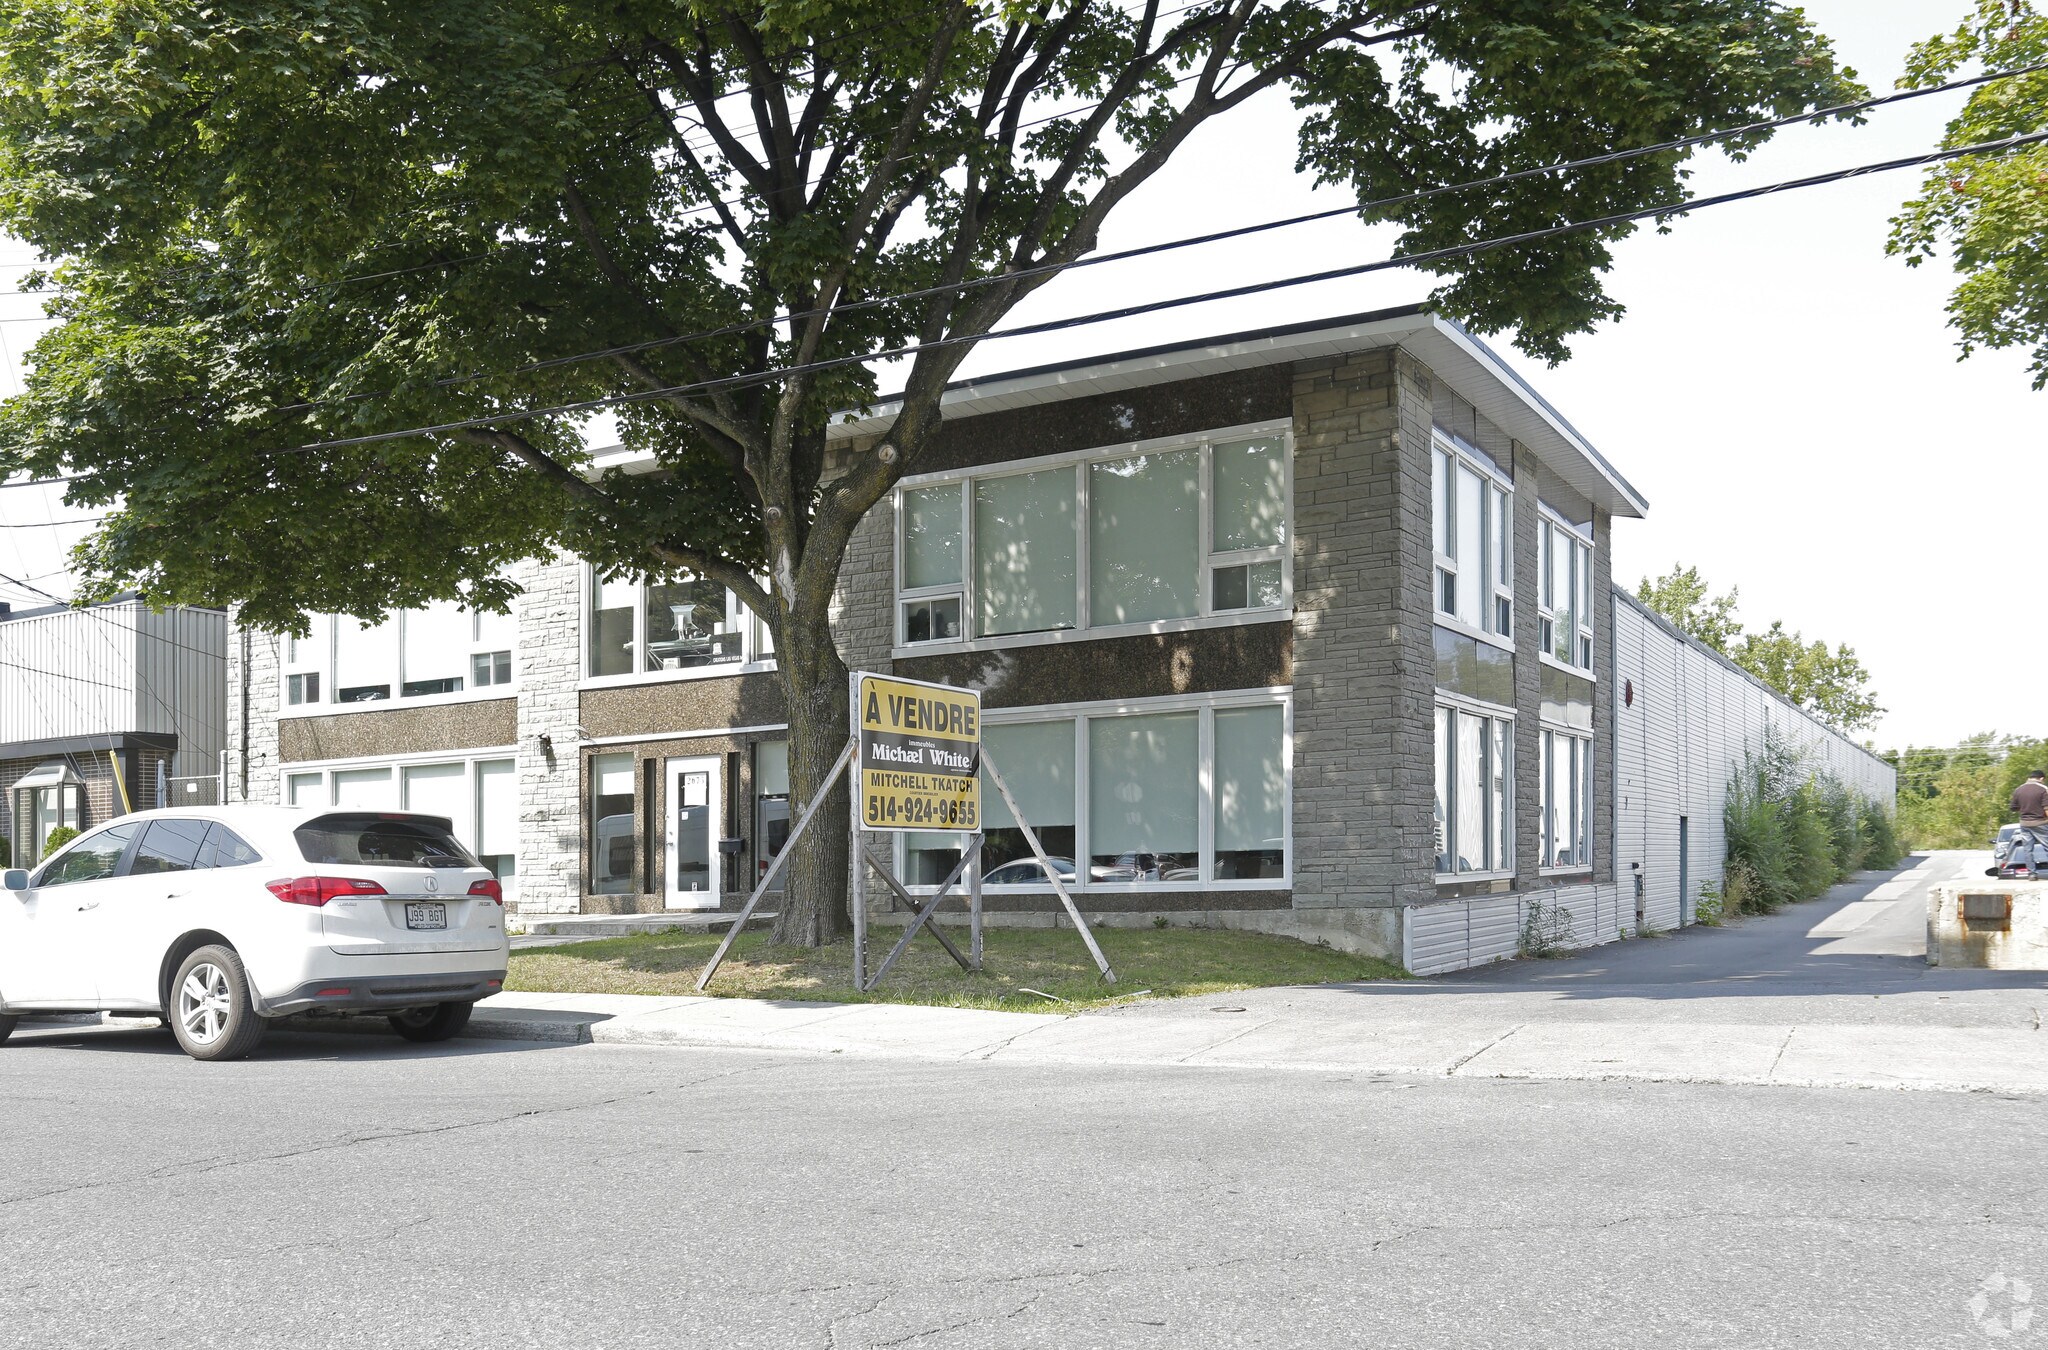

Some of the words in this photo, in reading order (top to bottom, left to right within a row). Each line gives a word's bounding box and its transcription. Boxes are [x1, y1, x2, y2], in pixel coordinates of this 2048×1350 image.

[865, 681, 881, 724] À
[888, 694, 976, 736] VENDRE
[929, 749, 970, 768] White
[871, 773, 928, 790] MITCHELL
[931, 777, 973, 793] TKATCH
[868, 795, 976, 825] 514-924-9655
[409, 910, 424, 922] J99
[429, 910, 443, 922] BGT
